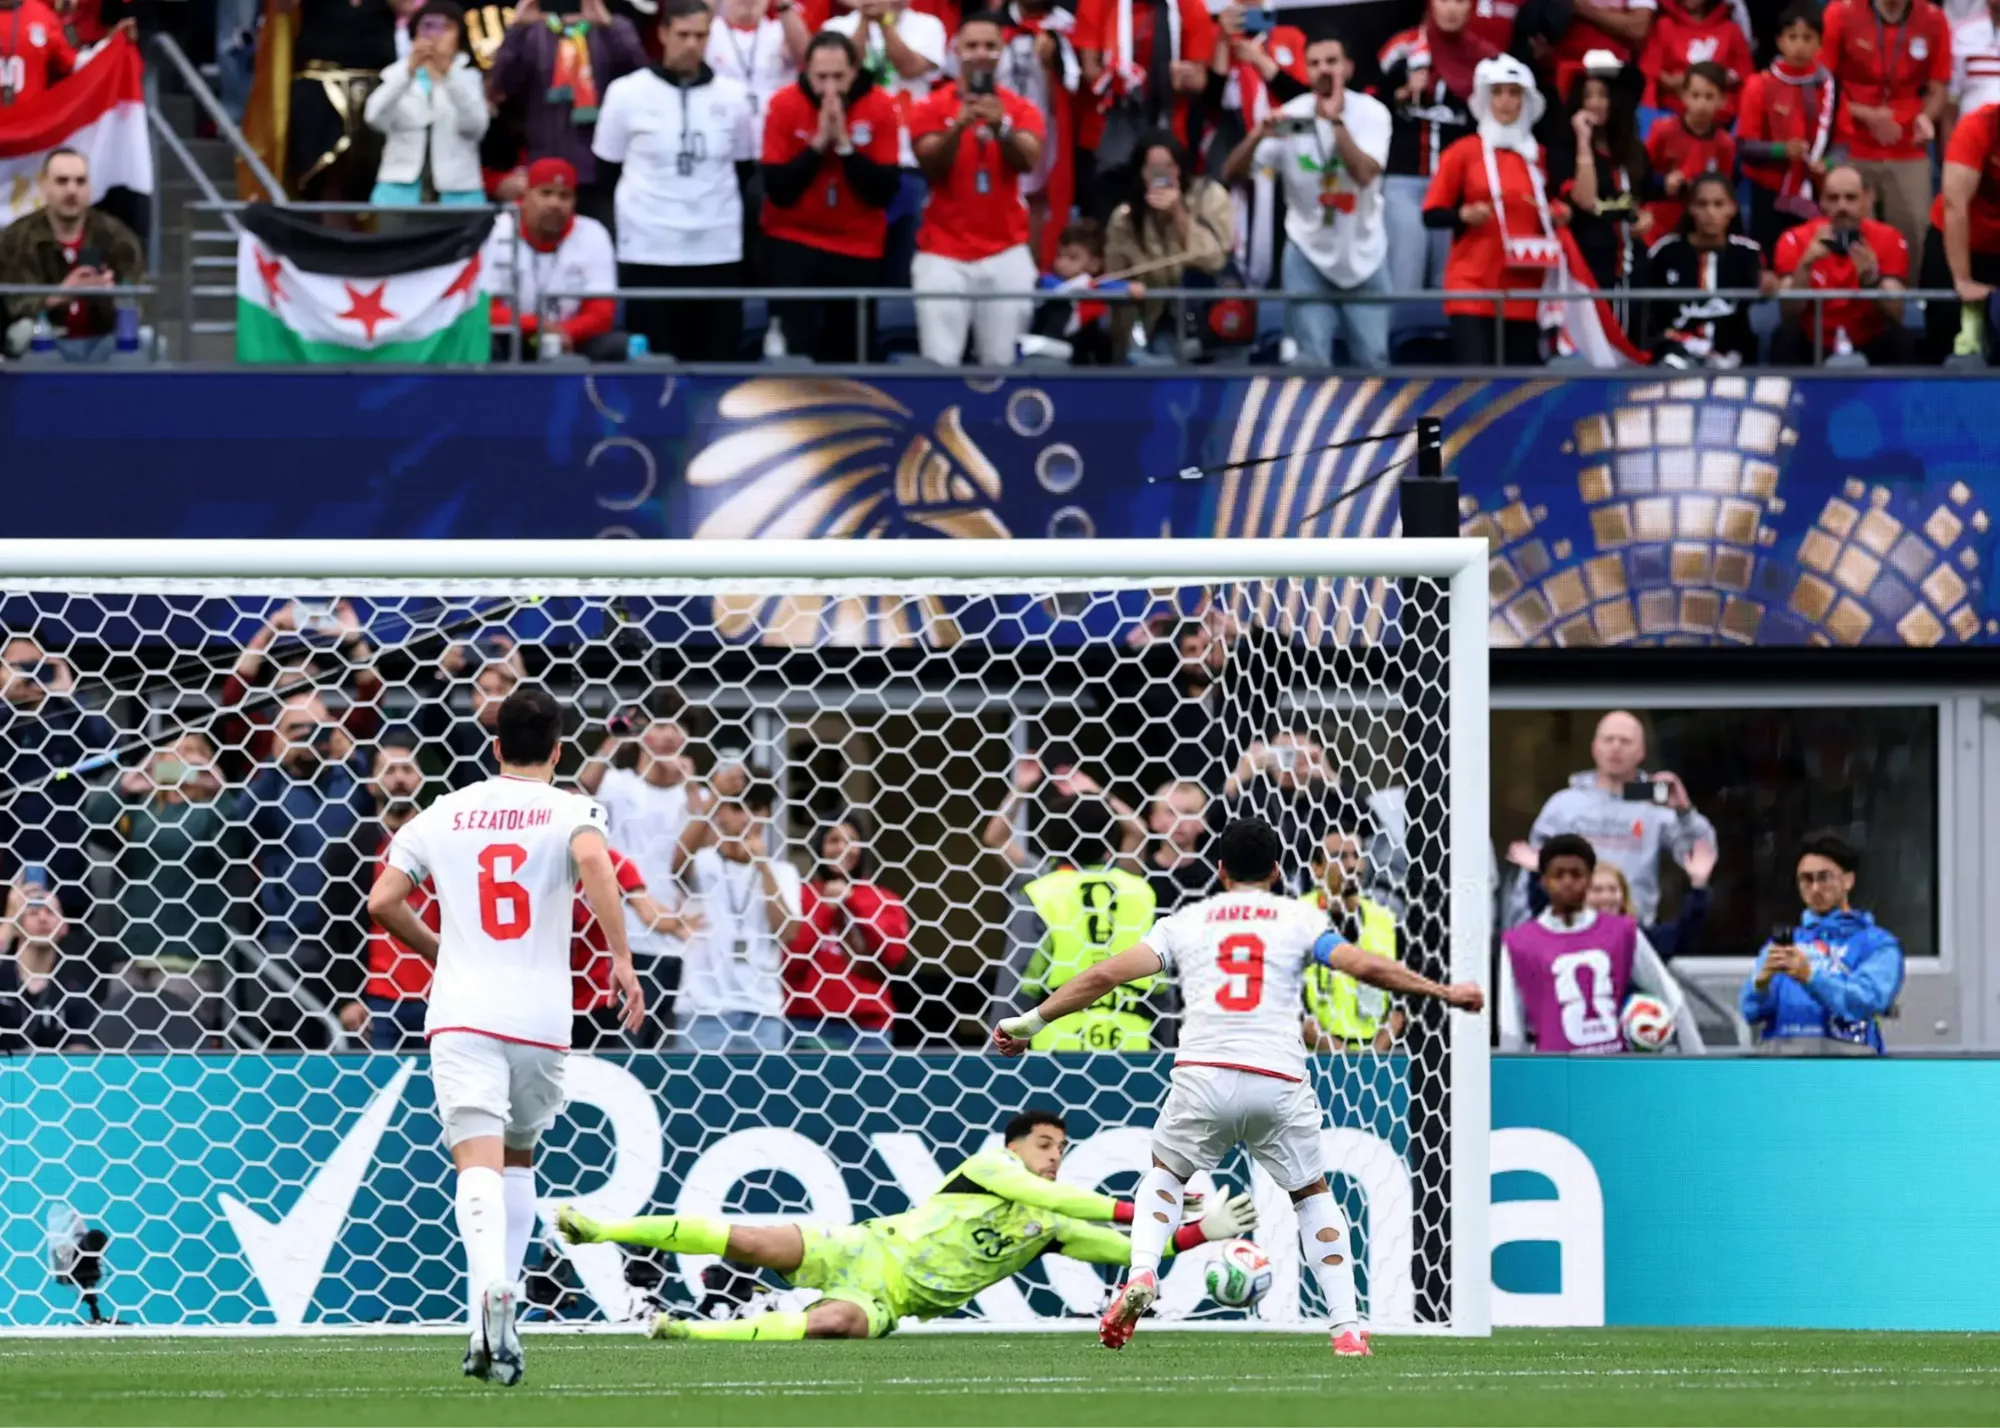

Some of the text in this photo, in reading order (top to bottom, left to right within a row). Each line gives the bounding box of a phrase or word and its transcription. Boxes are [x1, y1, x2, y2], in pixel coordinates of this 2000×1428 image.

[452, 808, 552, 831] S.EZATOLAHI
[477, 843, 532, 941] 6
[1214, 933, 1265, 1012] 9
